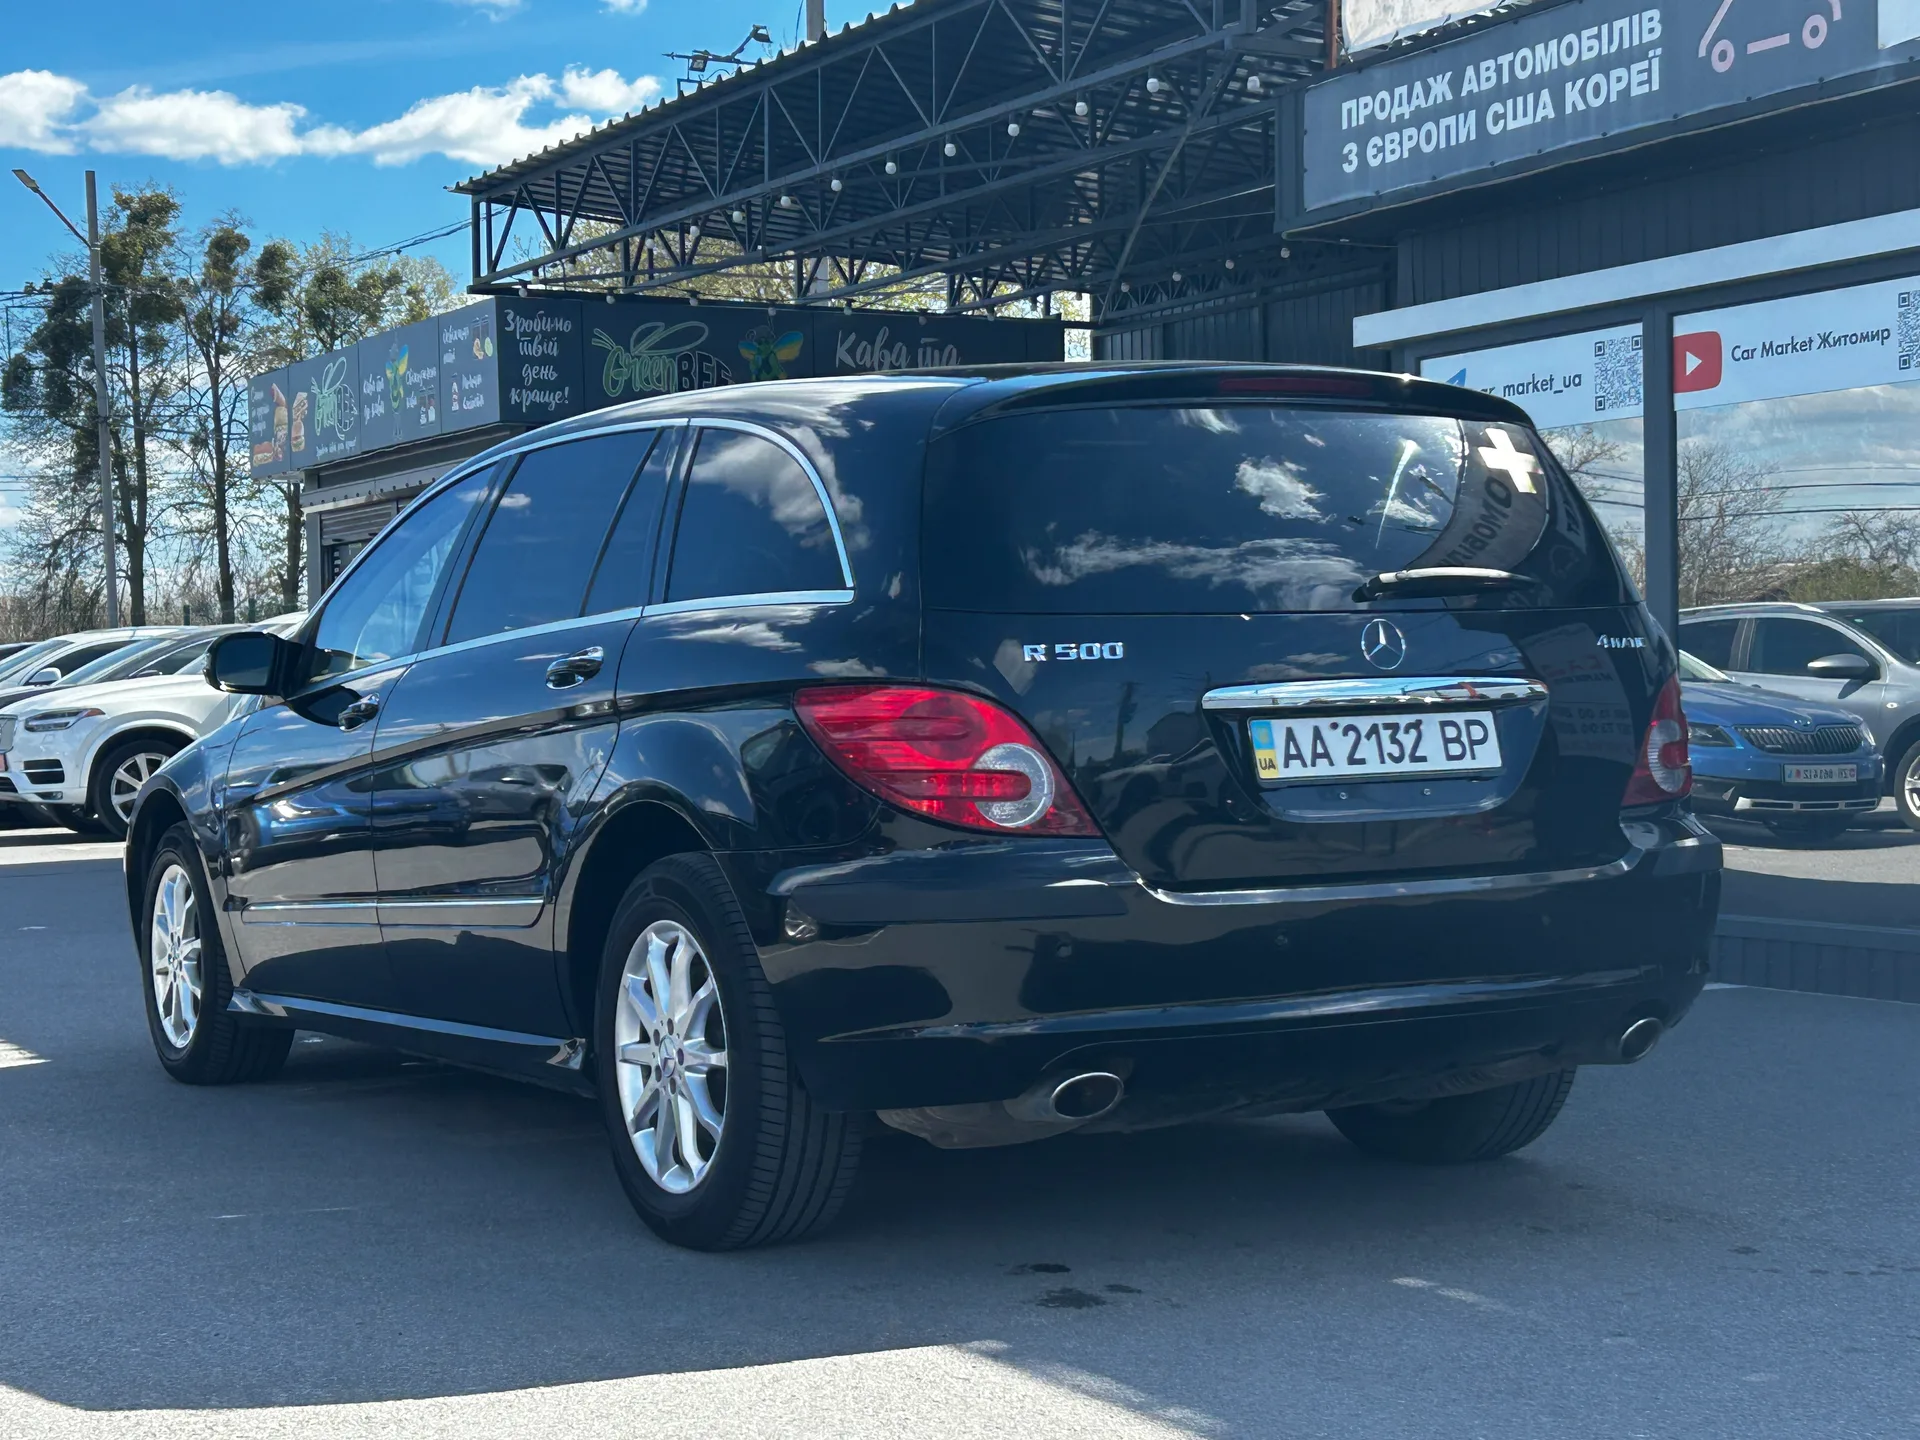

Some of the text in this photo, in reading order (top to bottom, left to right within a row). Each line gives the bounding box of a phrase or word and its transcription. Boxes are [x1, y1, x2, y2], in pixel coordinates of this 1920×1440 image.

[1341, 8, 1662, 130] ПРОДАЖ АВТОМОБІЛІВ
[1342, 47, 1662, 173] З ЄВРОПИ США КОРЕЇ
[519, 333, 559, 357] твій
[835, 326, 911, 371] Кава
[1731, 327, 1891, 362] Car Market Житомир
[522, 363, 558, 386] день
[509, 386, 569, 413] краще!
[1023, 642, 1124, 661] R 500
[1283, 719, 1489, 768] AA 2132 BP
[1259, 757, 1276, 771] UA
